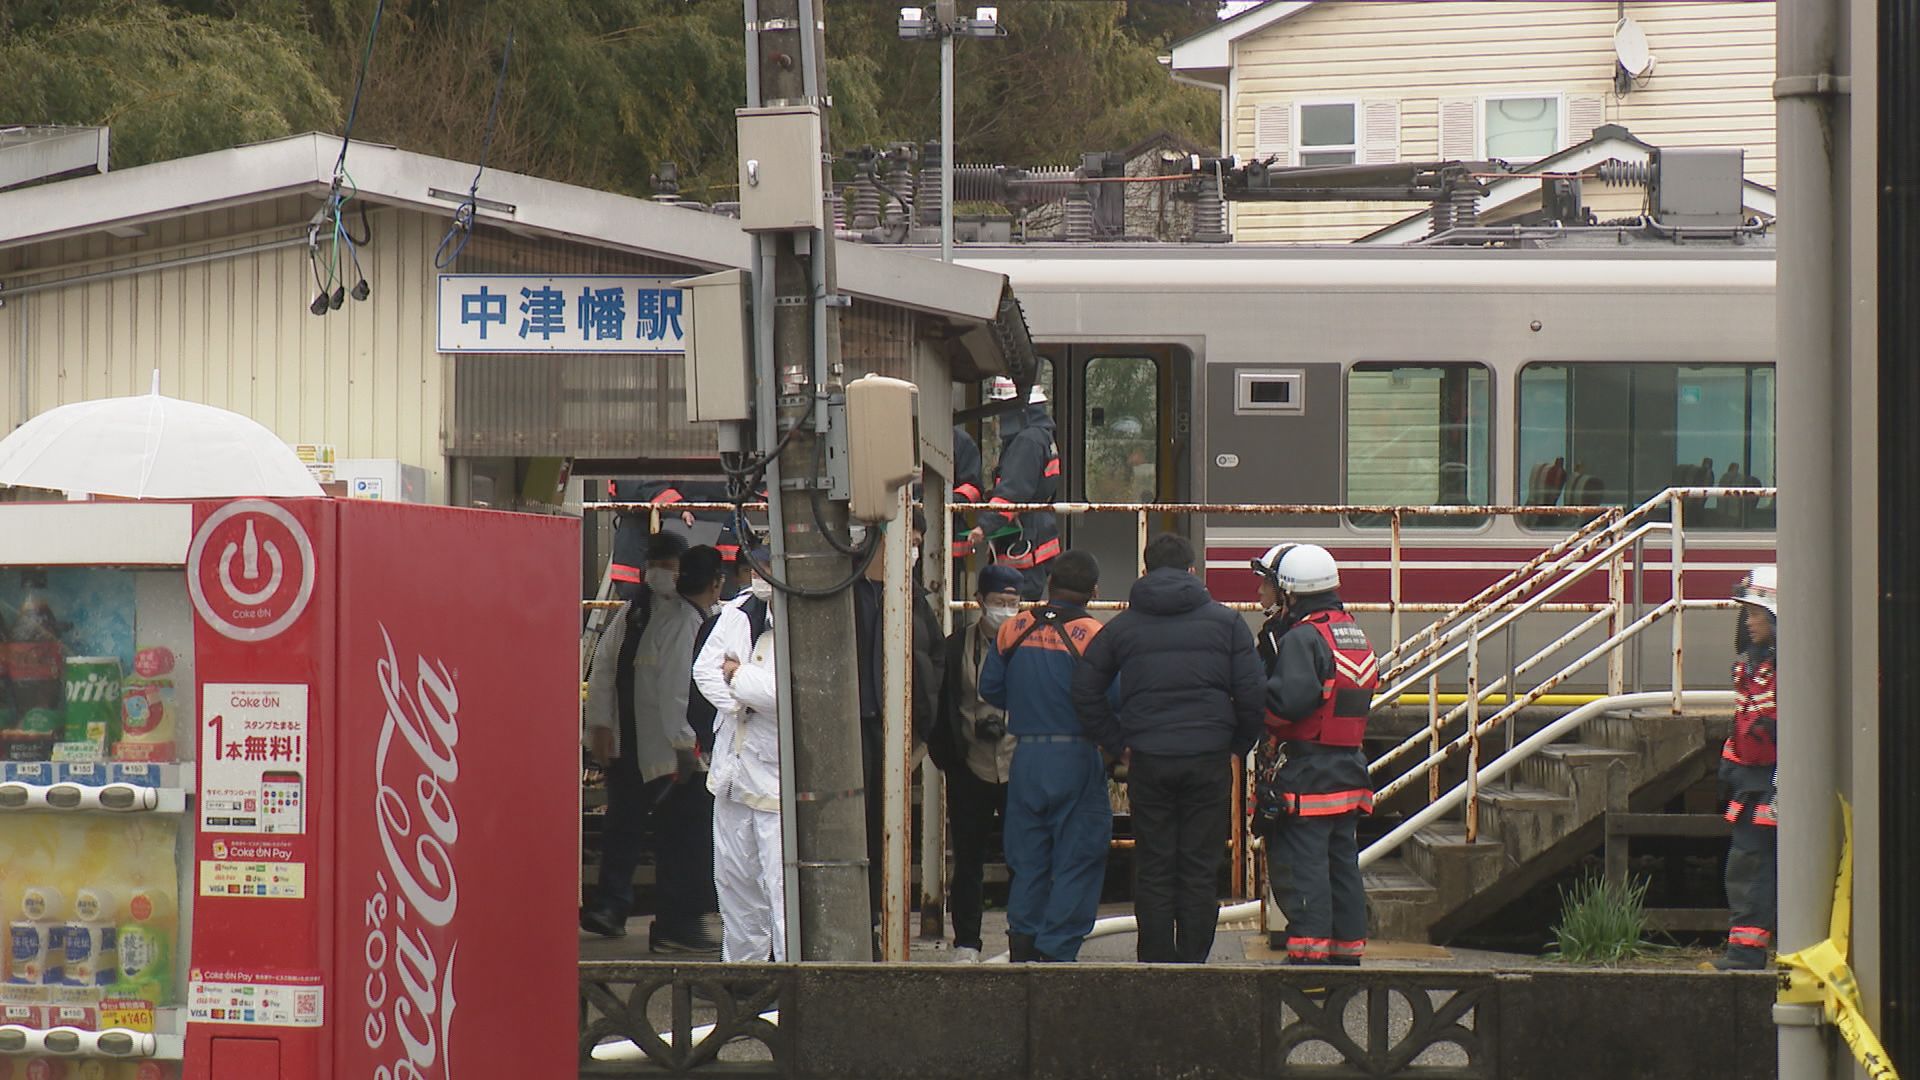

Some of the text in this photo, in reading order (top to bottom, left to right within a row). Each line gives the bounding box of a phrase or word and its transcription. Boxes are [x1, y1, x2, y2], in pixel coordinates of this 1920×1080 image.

[461, 285, 684, 341] 中津幡駅
[232, 609, 255, 619] Coke
[231, 695, 280, 708] Coke ON
[244, 720, 301, 731] スタンプたまると
[230, 847, 255, 857] Coke
[272, 849, 292, 860] Pay
[204, 971, 224, 980] Coke
[237, 973, 253, 982] Pay
[190, 1009, 207, 1017] VISA
